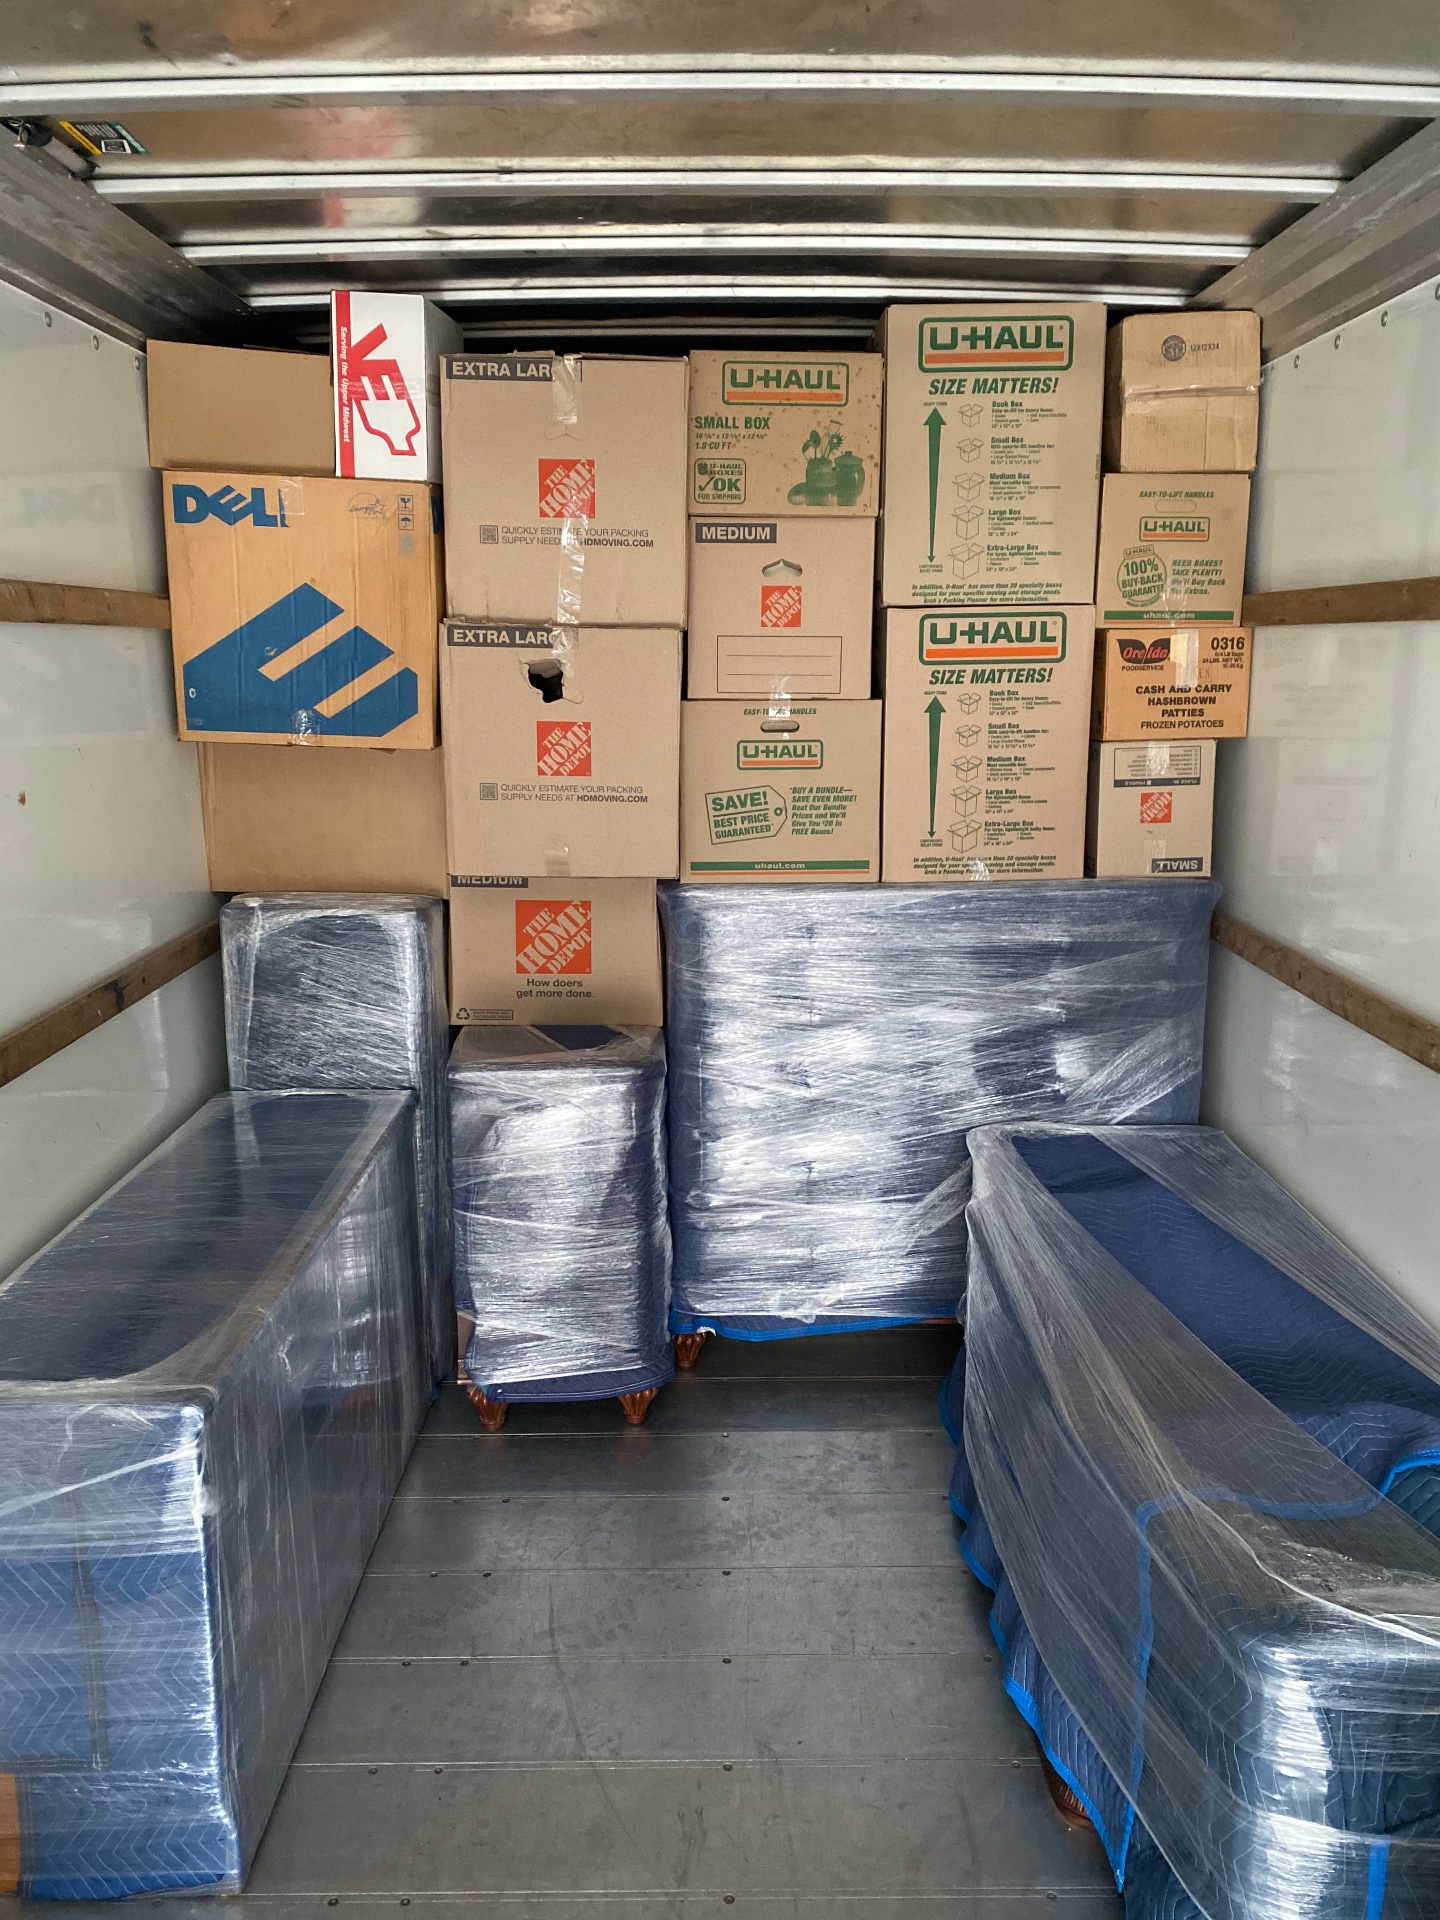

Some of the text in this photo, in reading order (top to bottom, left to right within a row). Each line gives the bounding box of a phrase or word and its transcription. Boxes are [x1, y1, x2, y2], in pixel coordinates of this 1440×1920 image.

[339, 326, 347, 360] Serving
[930, 325, 1064, 350] U-HAUL
[452, 361, 553, 378] EXTRA LAR
[730, 368, 841, 390] U-HAUL
[929, 377, 1059, 395] SIZE MATTERS!
[340, 378, 349, 405] Upper
[694, 416, 771, 430] SMALL BOX
[721, 442, 732, 450] FT
[539, 459, 595, 518] THE HOME DEPOT
[713, 478, 741, 492] OK
[711, 493, 742, 501] SHIPPING
[1139, 490, 1183, 498] EASY-TO-LIFT
[172, 483, 291, 528] DEL
[501, 526, 539, 536] QUICKLY
[584, 528, 609, 537] YOUR
[611, 529, 649, 538] PACKING
[1144, 520, 1206, 532] U-HAUL
[702, 527, 771, 540] MEDIUM
[501, 536, 535, 546] SUPPLY
[537, 537, 562, 546] NEED
[580, 538, 654, 548] HDMOVING.COM
[1124, 556, 1159, 577] 100%
[1171, 559, 1223, 567] NEED BOXES?
[1171, 568, 1222, 576] TAKE PLENTY!
[1121, 573, 1164, 589] BUY-BACK
[1191, 578, 1205, 587] Buy
[1207, 578, 1226, 586] Back
[1122, 583, 1165, 599] GUARANTEE
[760, 585, 802, 627] THE HOME DEPOT
[453, 629, 510, 644] EXTRA
[929, 621, 1057, 645] U-HAUL
[1211, 636, 1245, 651] 0316
[1121, 664, 1165, 672] FOODSERVICE
[929, 668, 1053, 685] SIZE MATTERS!
[1135, 683, 1233, 695] CASH AND CARRY
[1147, 696, 1217, 706] HASHBROWN
[1161, 708, 1205, 718] PATTIES
[1140, 719, 1224, 730] FROZEN POTATOES
[537, 721, 592, 776] THE HOME DEPOT
[742, 744, 818, 759] U-HAUL
[500, 783, 643, 794] QUICKLY ESTIMATE YOUR PACKING
[501, 792, 648, 803] SUPPLY NEEDS AT HDMOVING.COM
[711, 791, 769, 812] SAVE!
[791, 795, 811, 803] SAVE
[812, 795, 831, 803] EVEN
[713, 813, 769, 829] BEST PRICE
[1156, 860, 1198, 870] SMALL
[515, 900, 592, 974] THE HOME DEPOT
[526, 978, 583, 988] How doers
[516, 989, 595, 999] get more done.
